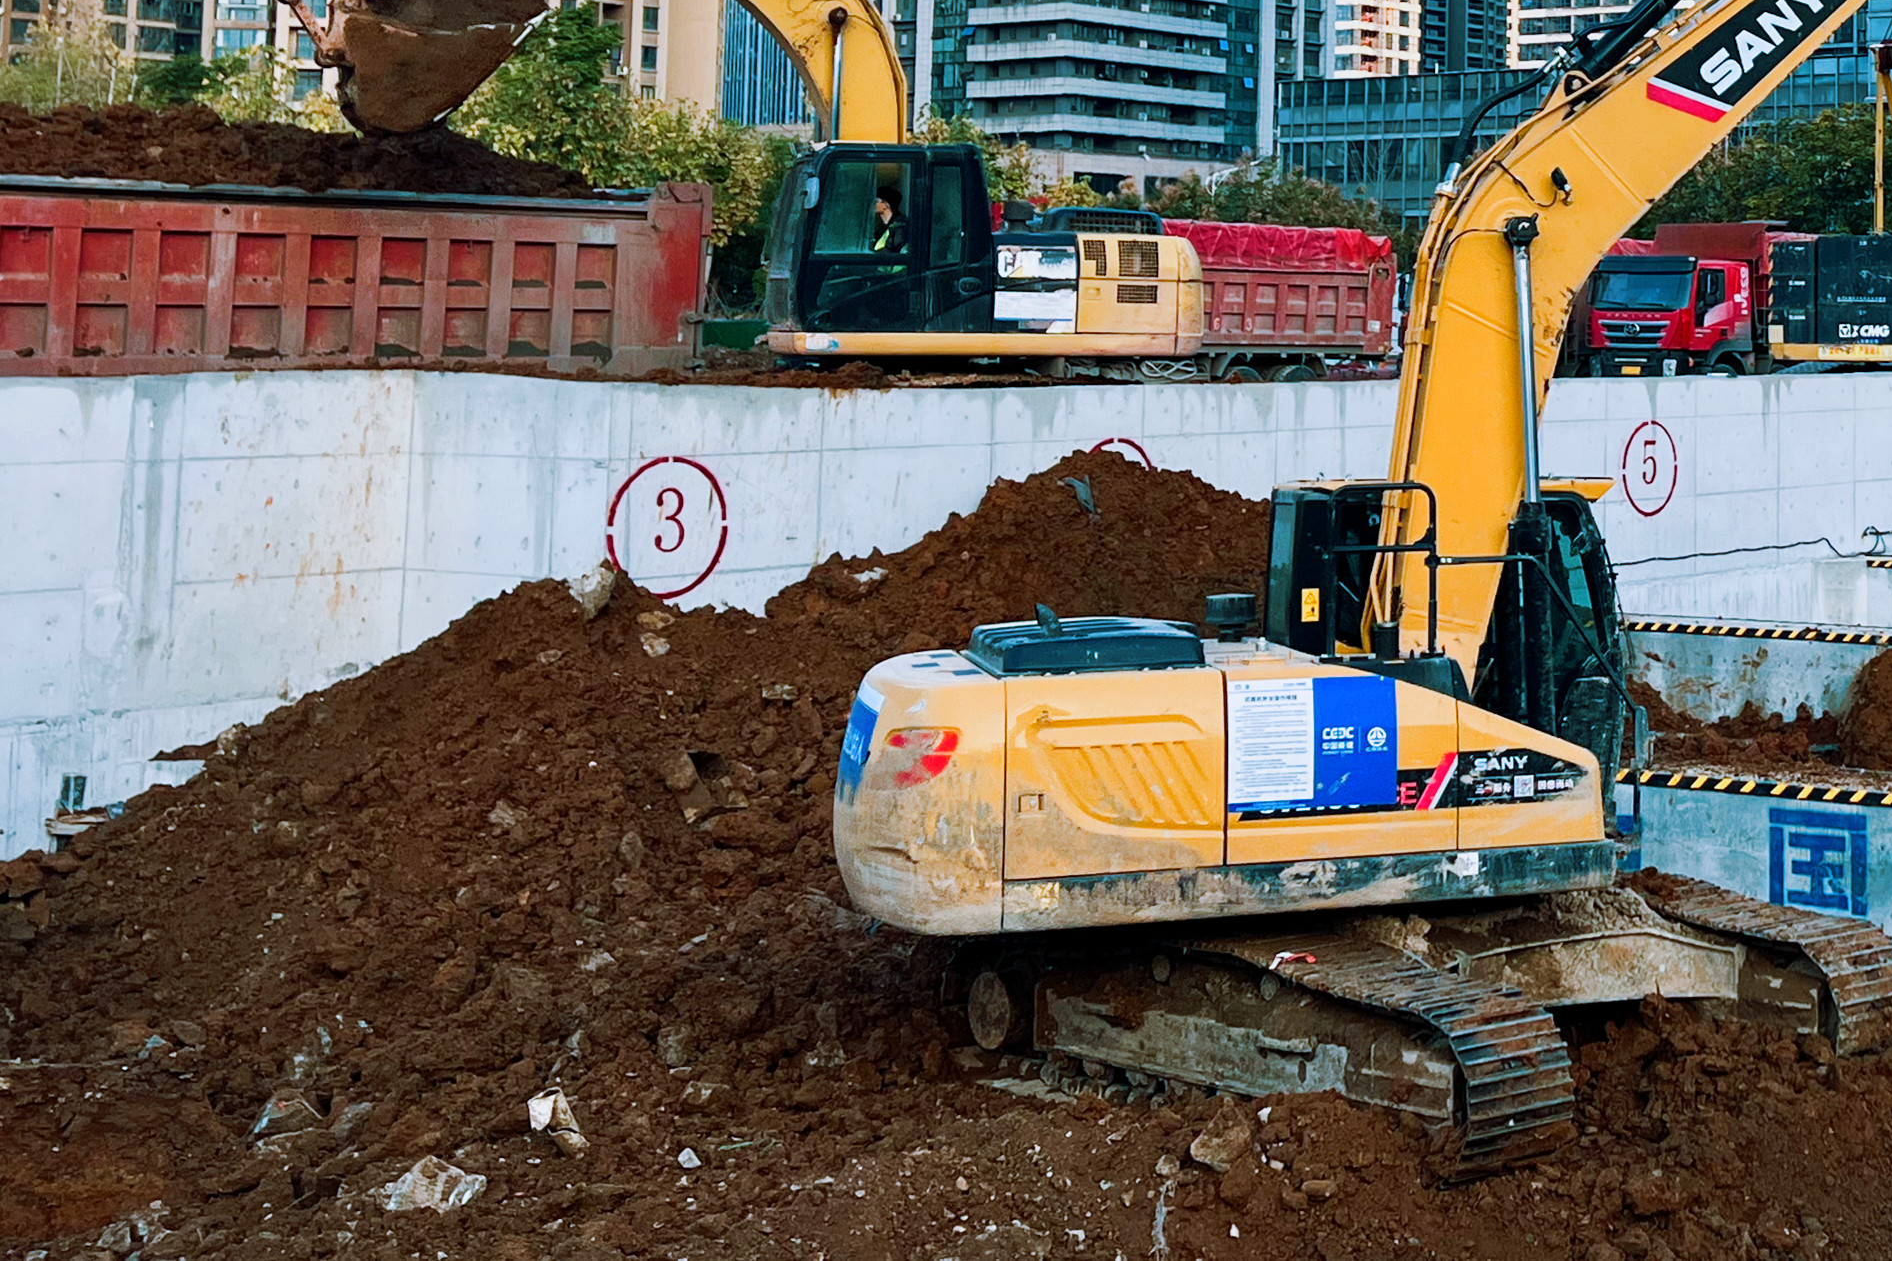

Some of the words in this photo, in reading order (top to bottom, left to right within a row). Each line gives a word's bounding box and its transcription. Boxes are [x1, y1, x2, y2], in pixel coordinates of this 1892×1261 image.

[1851, 325, 1890, 338] XCMG
[1642, 440, 1657, 485] 5
[655, 487, 685, 552] 3
[1474, 755, 1528, 771] SANY
